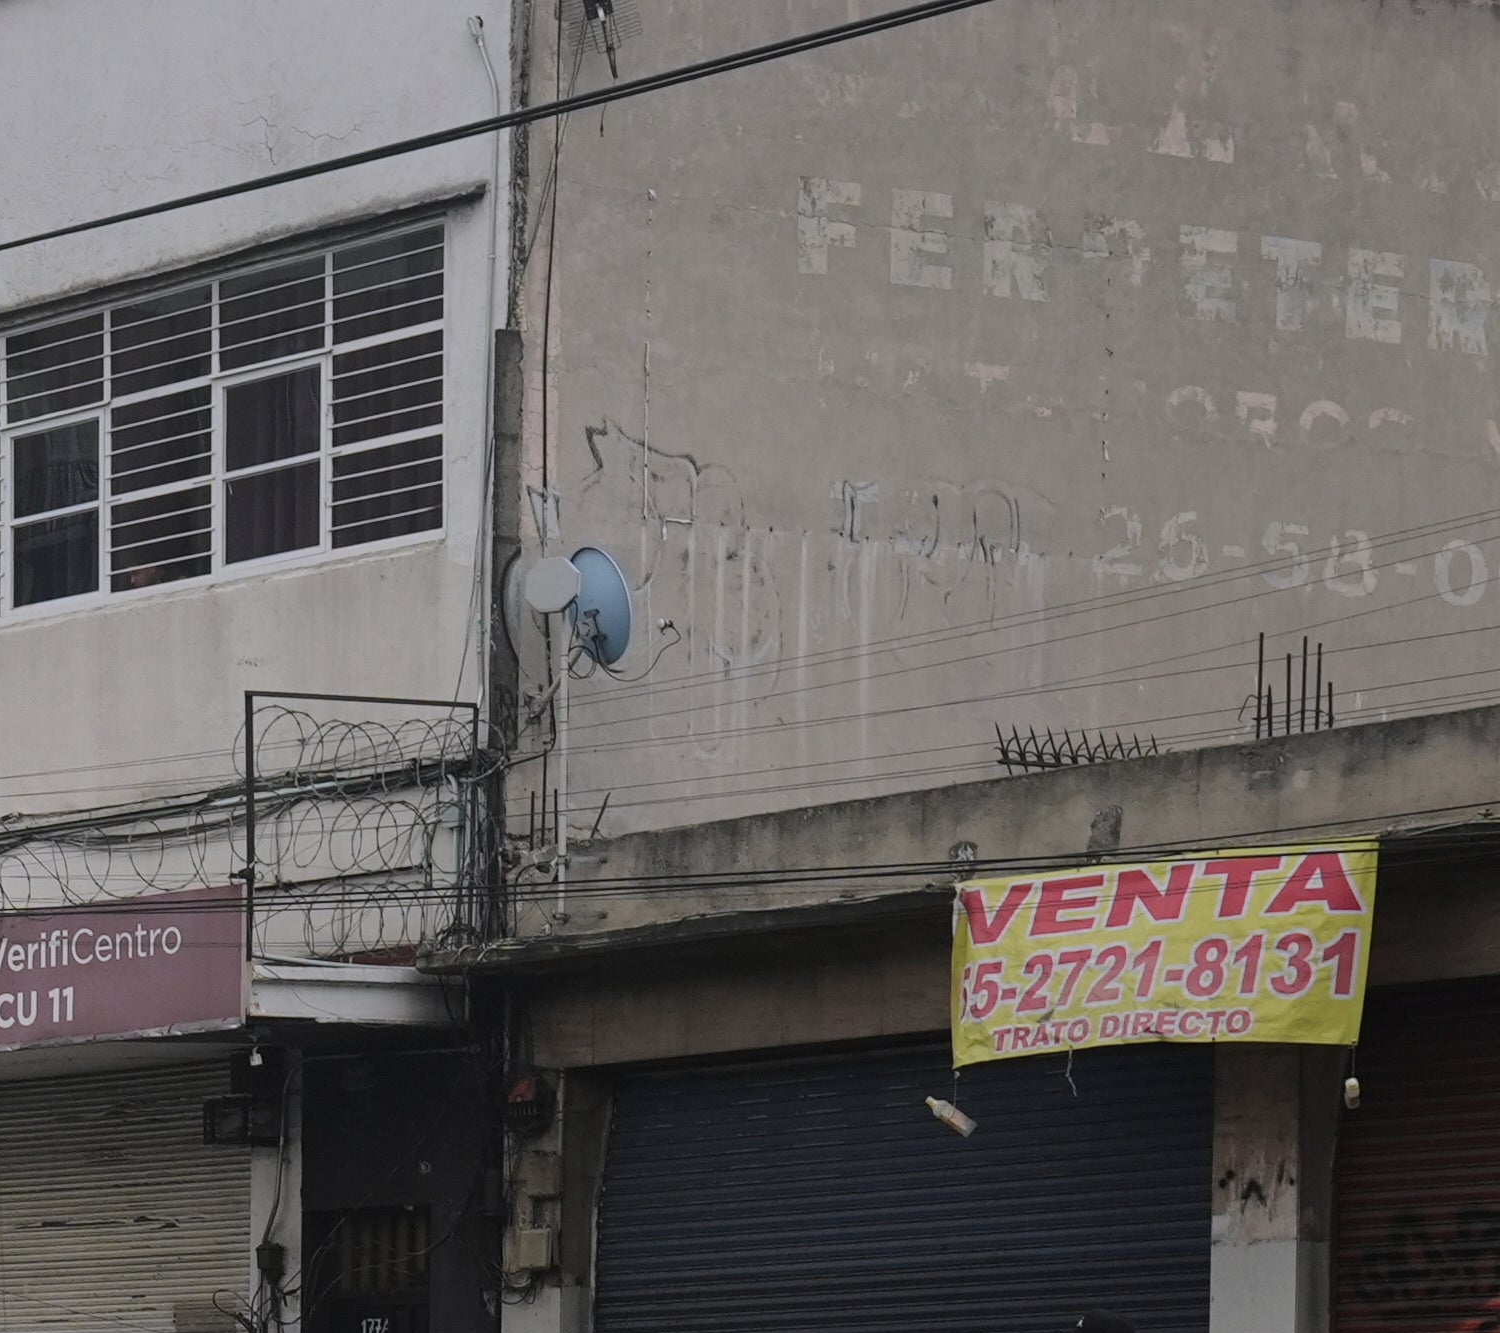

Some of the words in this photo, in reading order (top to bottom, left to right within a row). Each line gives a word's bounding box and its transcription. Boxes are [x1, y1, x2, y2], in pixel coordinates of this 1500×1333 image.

[959, 852, 1362, 944] VENTA
[48, 985, 75, 1024] 11
[992, 1019, 1091, 1052] TRATO
[1099, 1009, 1252, 1041] DIRECTO
